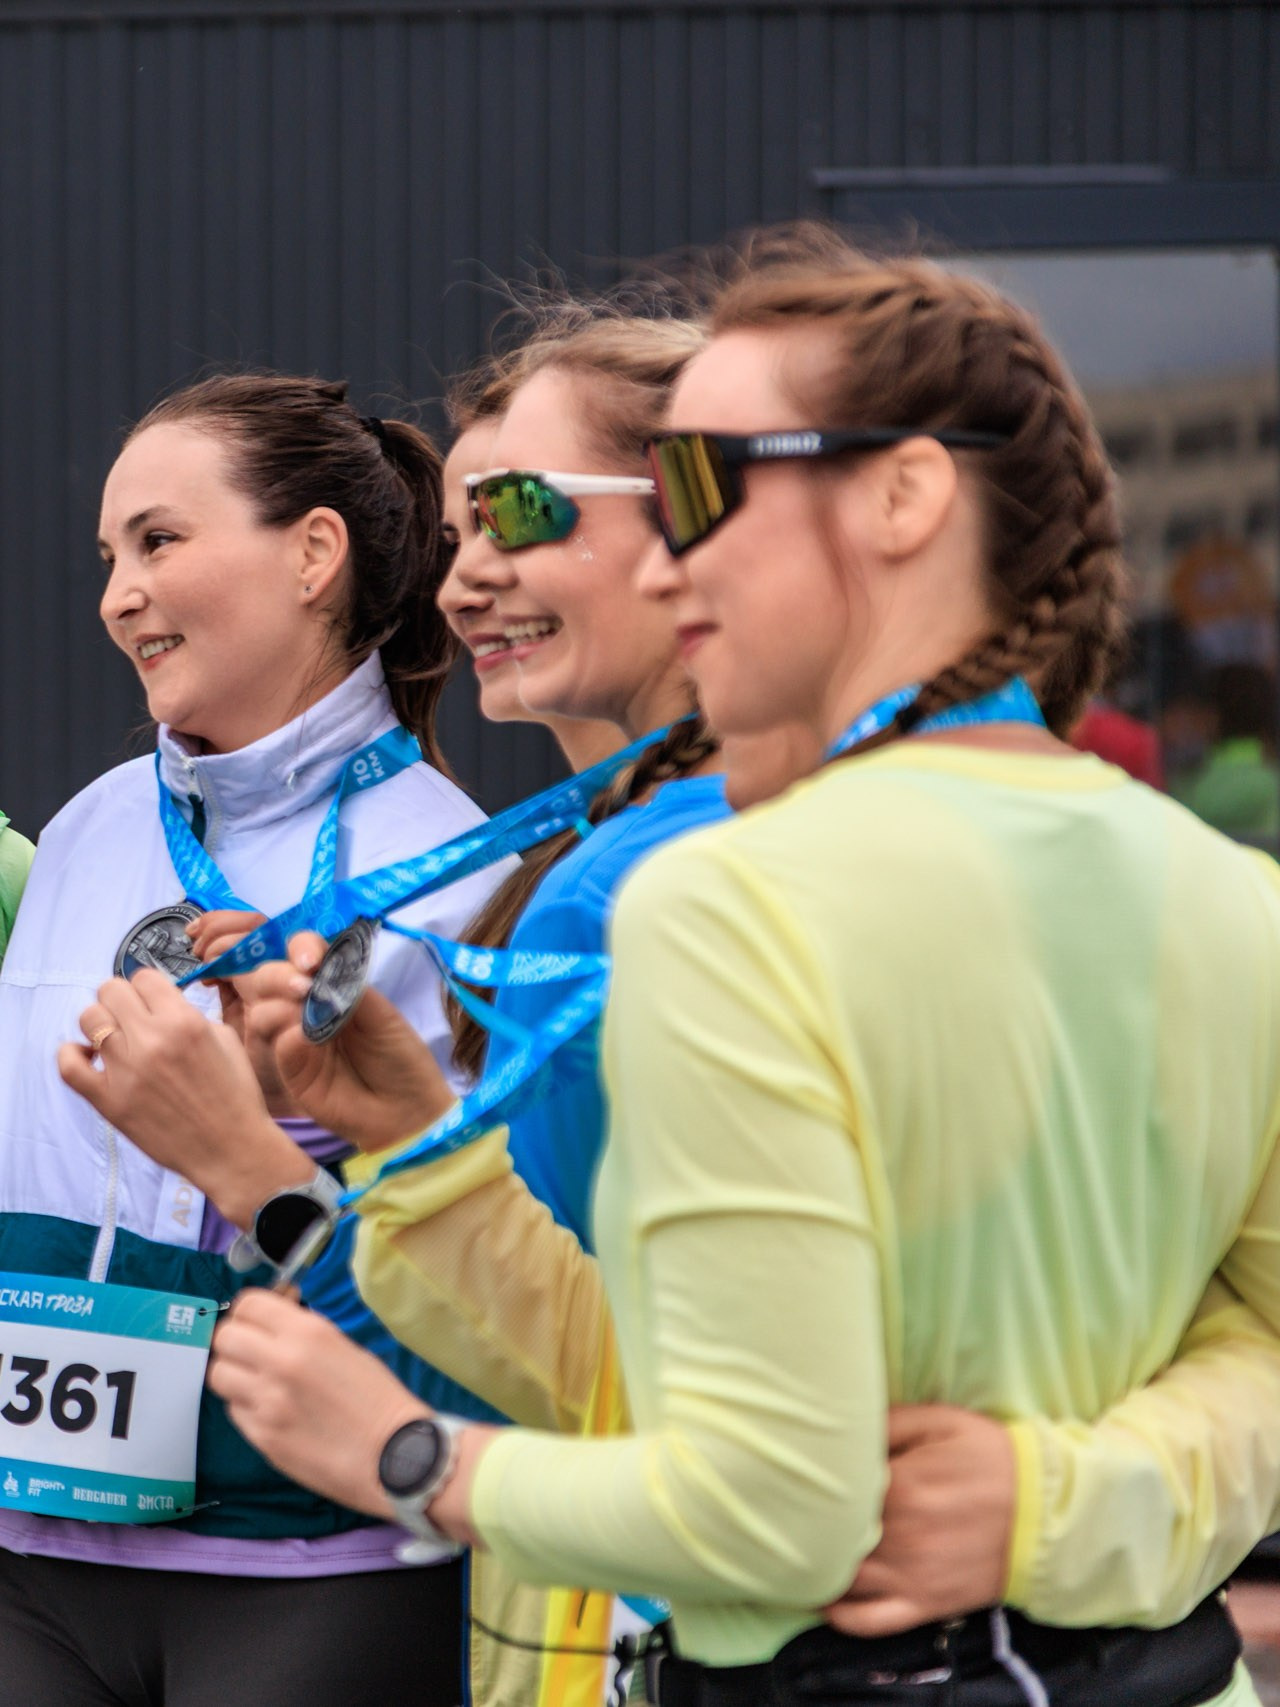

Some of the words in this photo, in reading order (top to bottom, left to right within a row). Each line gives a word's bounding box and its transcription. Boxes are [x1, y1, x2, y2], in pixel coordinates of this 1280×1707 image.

[353, 759, 373, 786] 10
[45, 1293, 95, 1317] ГРОЗА
[28, 1478, 61, 1491] BRIGHT
